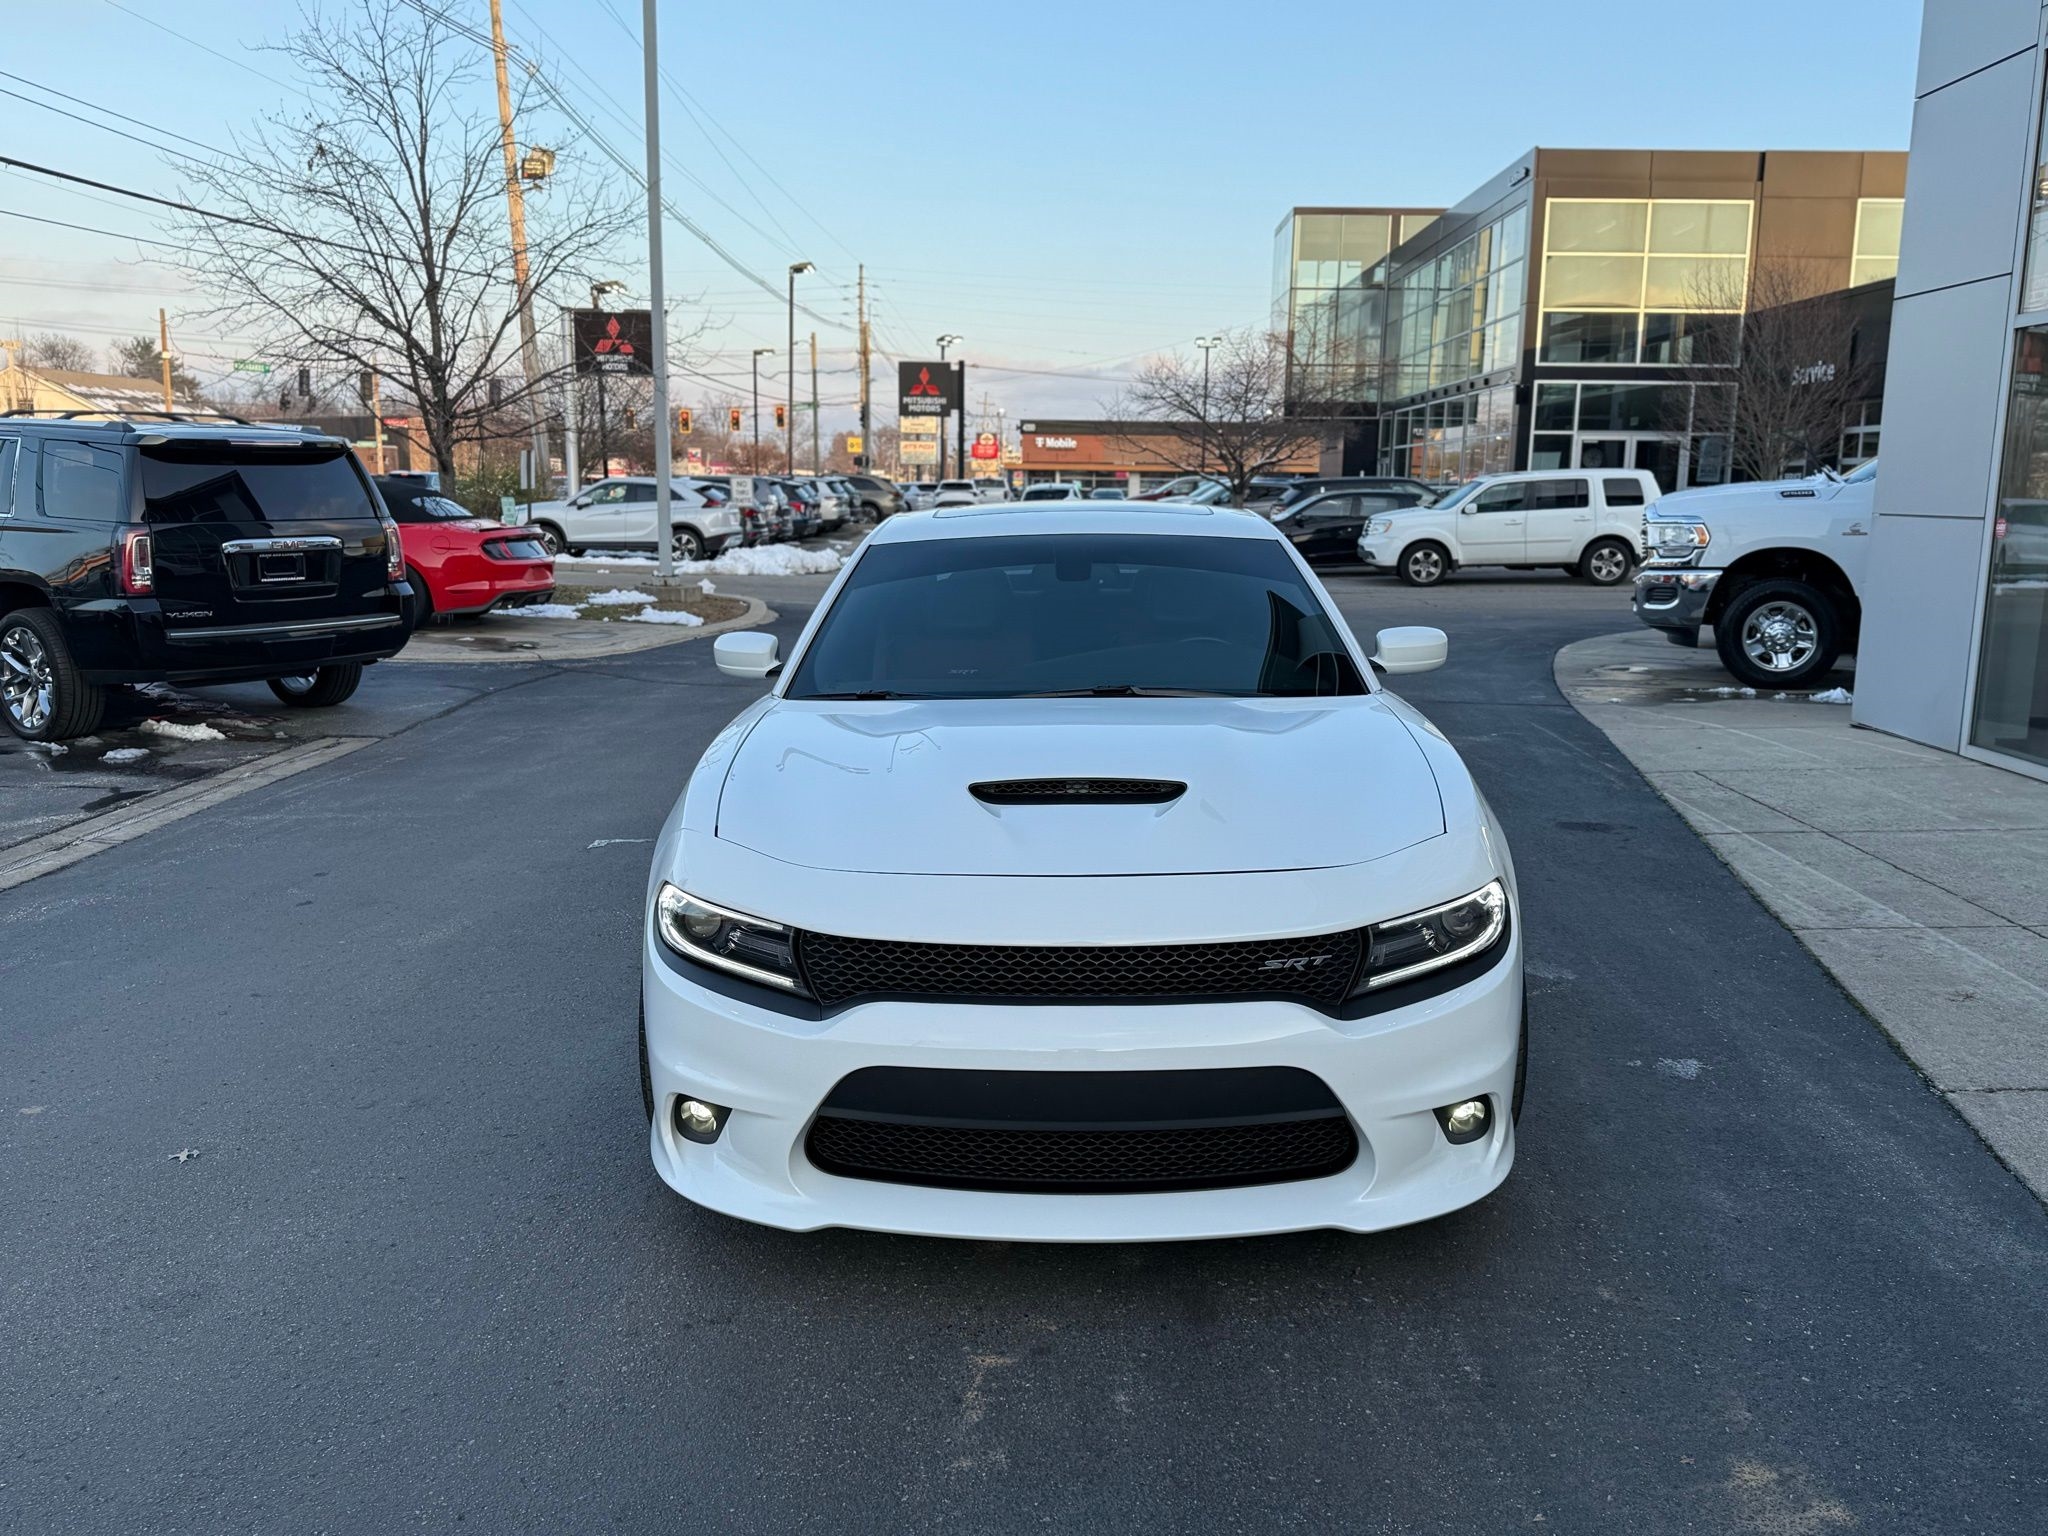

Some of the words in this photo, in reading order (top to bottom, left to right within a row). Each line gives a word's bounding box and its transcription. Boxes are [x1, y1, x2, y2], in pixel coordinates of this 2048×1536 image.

[602, 363, 628, 371] MOTORS
[1791, 360, 1835, 386] Service
[903, 396, 948, 405] MITSUBISHI
[908, 404, 942, 413] MOTORS
[735, 480, 748, 488] NO
[270, 541, 308, 550] GMC
[165, 610, 213, 619] YUKON
[1258, 954, 1333, 972] SRT
